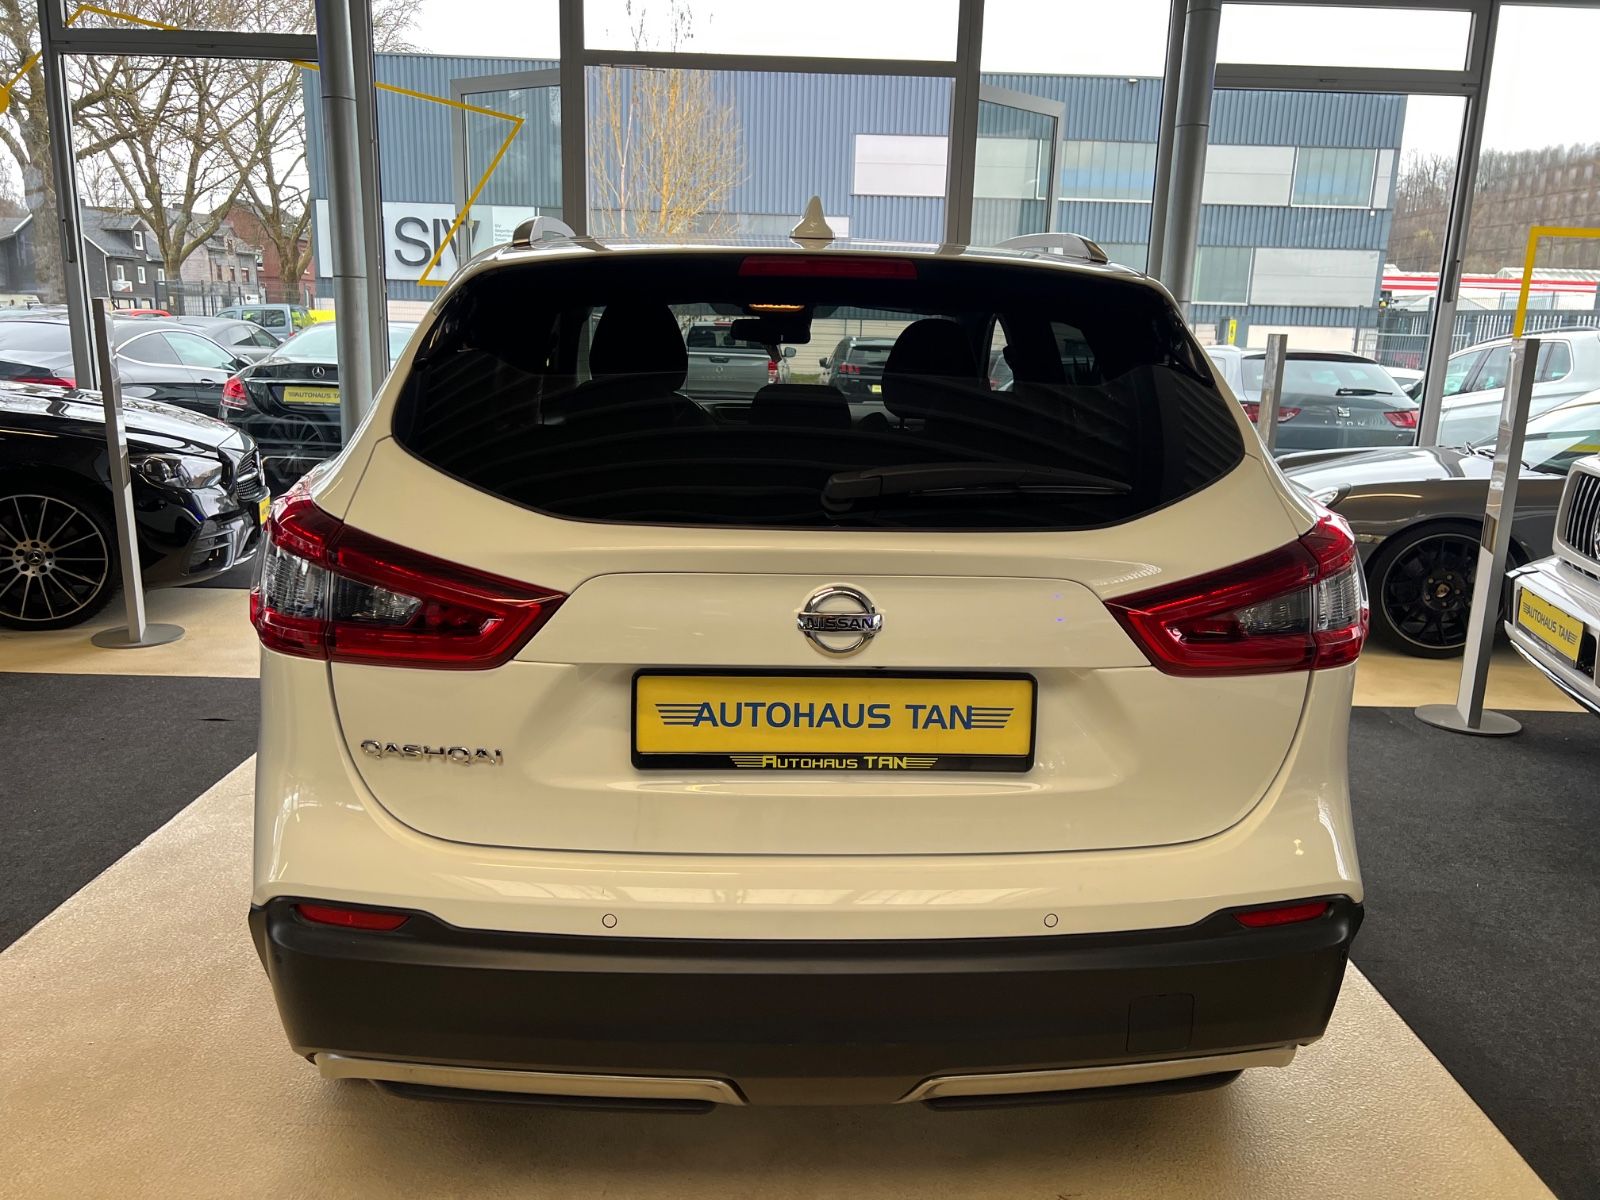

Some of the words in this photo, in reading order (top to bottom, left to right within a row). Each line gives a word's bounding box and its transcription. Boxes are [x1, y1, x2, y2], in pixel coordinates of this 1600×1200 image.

[806, 617, 874, 629] NISSAN
[1528, 605, 1557, 633] AUTOHAUS
[1559, 625, 1571, 642] TAN
[692, 702, 891, 729] AUTOHAUS
[904, 704, 973, 730] TAN
[361, 740, 504, 766] QASHQAI
[863, 756, 907, 769] TAN
